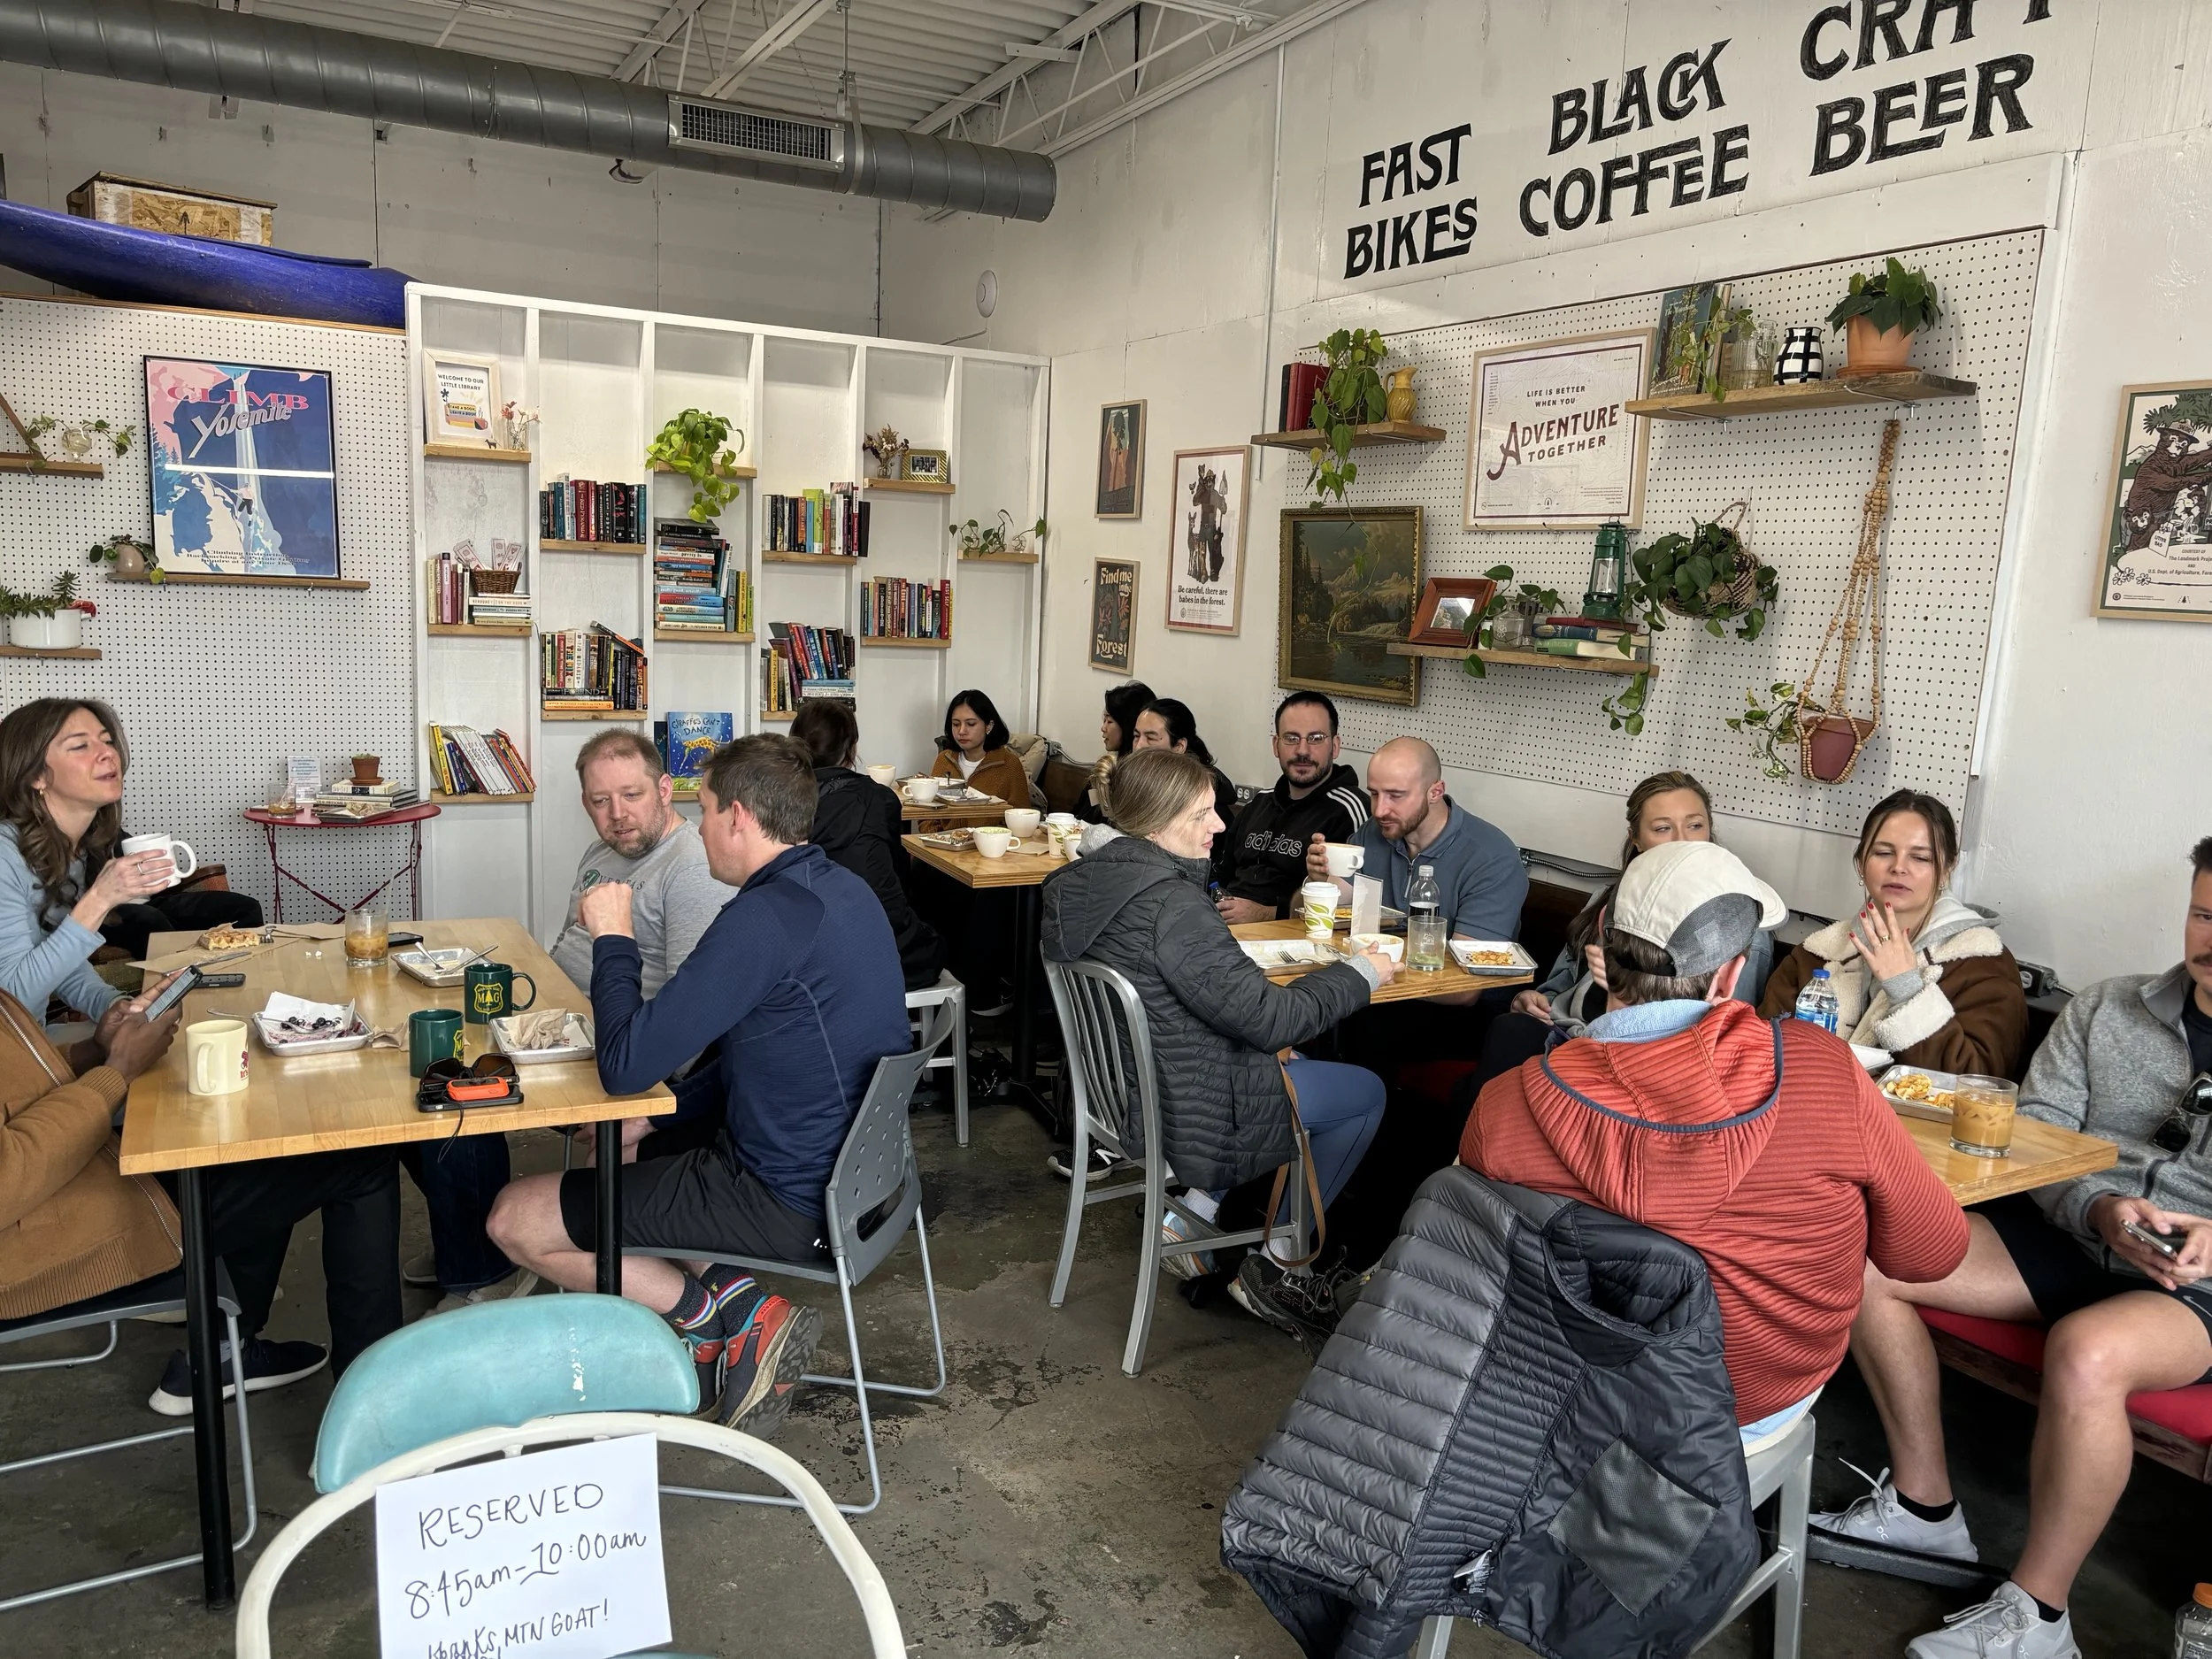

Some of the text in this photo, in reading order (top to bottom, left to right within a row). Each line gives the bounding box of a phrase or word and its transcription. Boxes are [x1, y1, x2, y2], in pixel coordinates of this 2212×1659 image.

[1801, 0, 2052, 81] CRA
[1548, 38, 1732, 157] BLACK
[1809, 53, 2035, 177] BEER
[1358, 123, 1471, 207] FAST
[1519, 123, 1750, 237] COFFEE
[1344, 197, 1479, 280] BIKES
[437, 373, 464, 382] WELCOME
[1556, 385, 1586, 395] BETTER
[167, 386, 309, 411] CLIMB
[188, 403, 292, 459] Yosemite
[1486, 403, 1620, 480] ADVENTURE
[1528, 435, 1607, 462] TOGETHER
[1100, 568, 1132, 585] Find me
[1179, 595, 1193, 603] babes
[1209, 597, 1225, 606] forest.
[1096, 634, 1127, 659] Forest
[672, 718, 701, 729] GIRAFFES
[684, 726, 711, 736] DANCE
[1245, 830, 1302, 857] adidas
[419, 1483, 603, 1550] RESERVED
[504, 1617, 544, 1647] MTN
[552, 1598, 609, 1636] GOAT!
